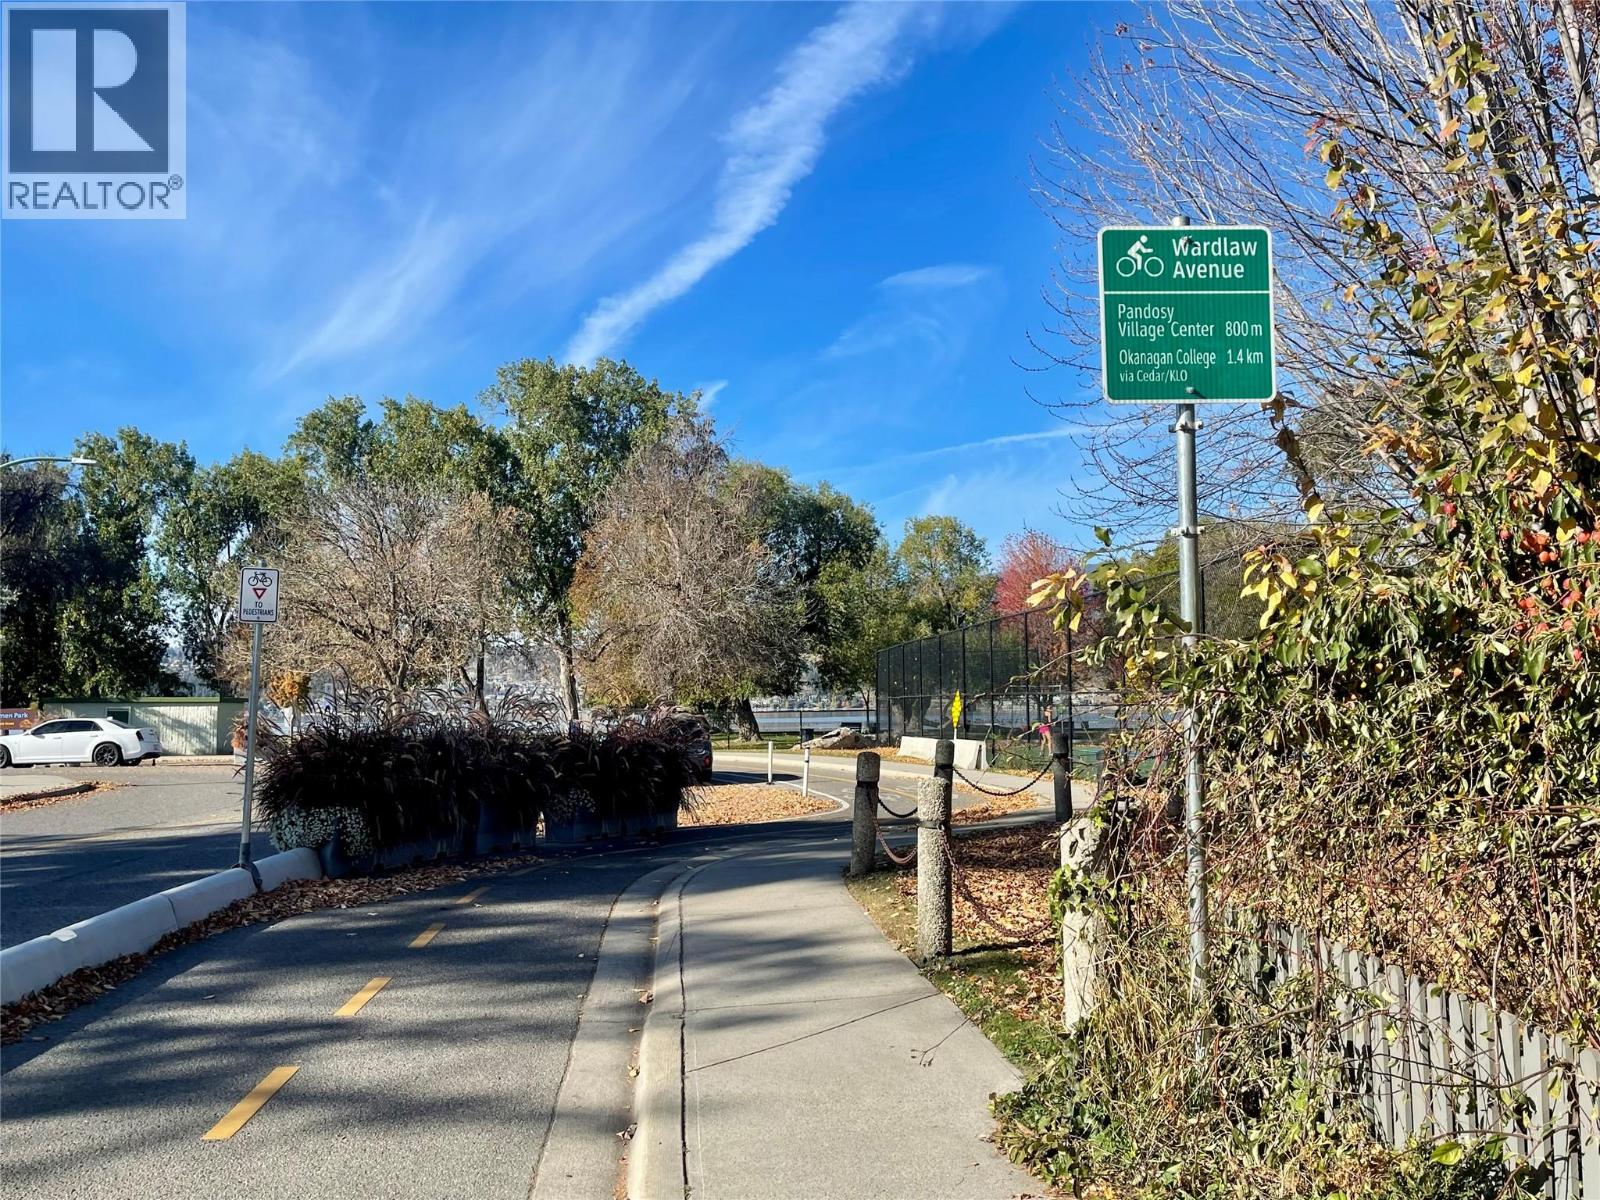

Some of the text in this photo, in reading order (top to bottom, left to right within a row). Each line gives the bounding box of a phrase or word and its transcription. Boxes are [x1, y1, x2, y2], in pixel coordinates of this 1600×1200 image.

[1172, 237, 1258, 257] Wardlaw
[1172, 261, 1245, 279] Avenue
[1118, 303, 1175, 323] Pandosy
[1118, 321, 1165, 342] Village
[1170, 321, 1215, 337] Center
[1119, 349, 1173, 369] Okanagan
[1176, 349, 1217, 369] College
[1119, 369, 1188, 384] via Cedar/KLO
[243, 608, 274, 616] PEDESTRIANS
